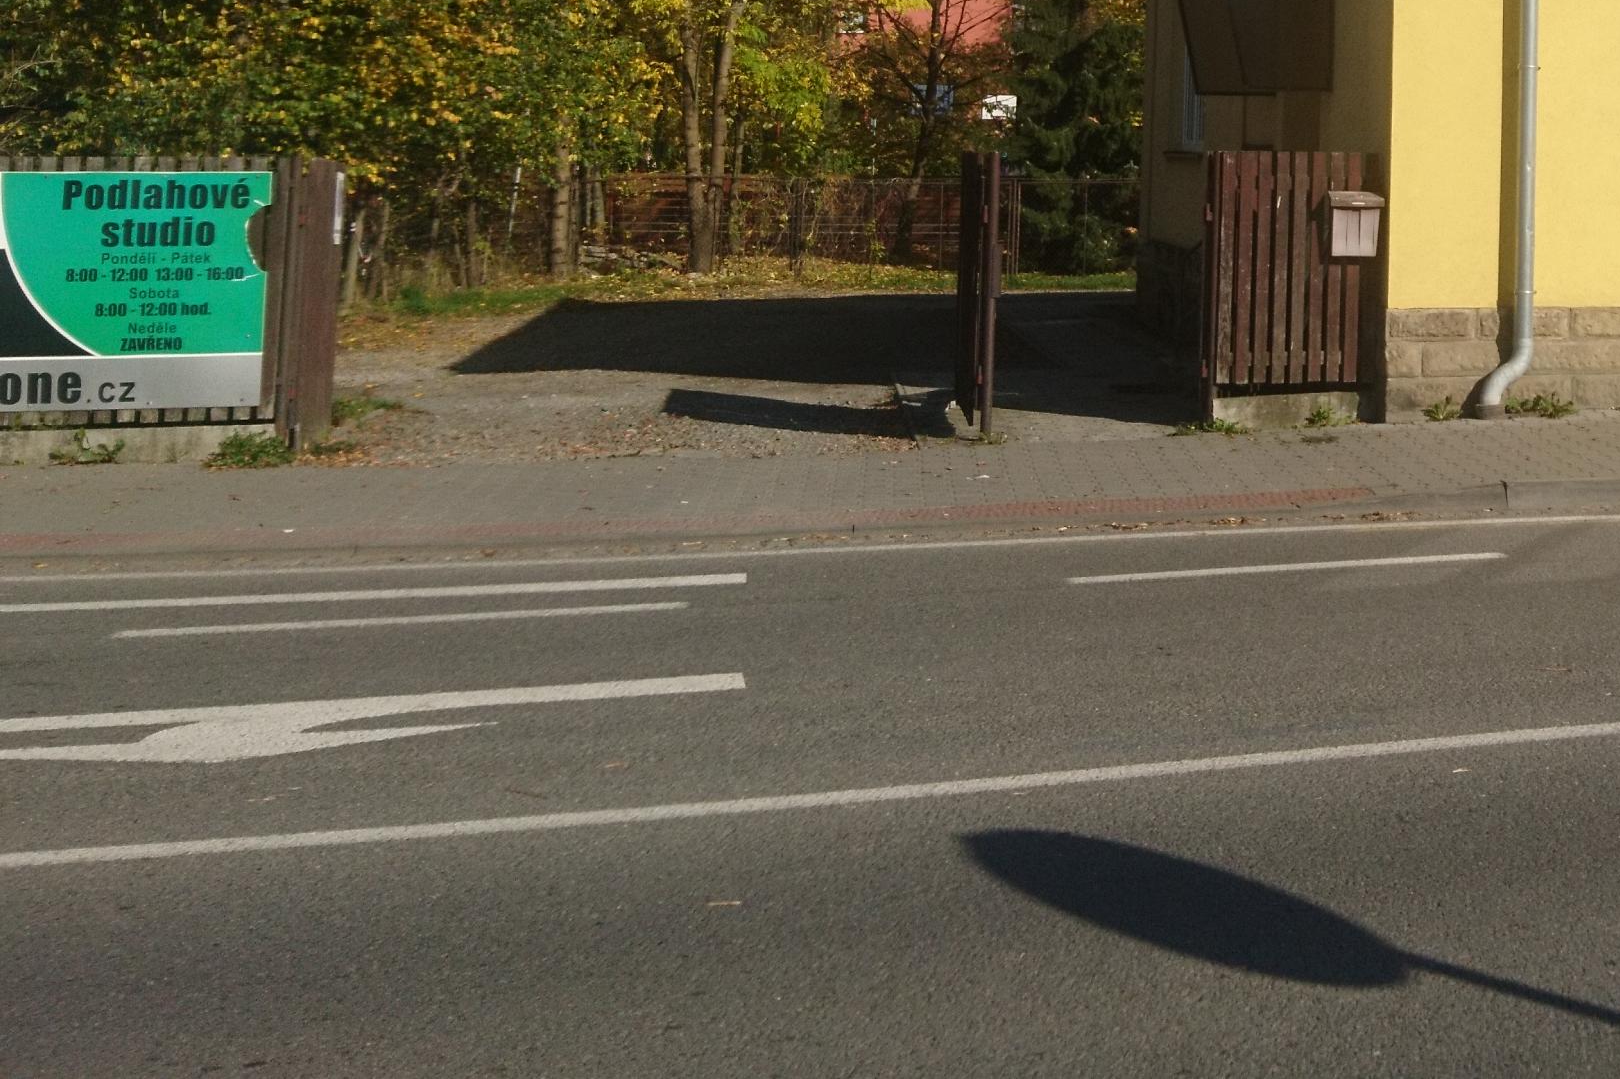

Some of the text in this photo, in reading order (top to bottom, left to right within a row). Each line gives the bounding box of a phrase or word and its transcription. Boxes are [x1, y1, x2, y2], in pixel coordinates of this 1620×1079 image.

[62, 177, 250, 210] Podlahové
[101, 216, 216, 248] studio
[171, 252, 211, 264] Pátek
[65, 268, 98, 282] 8:00
[110, 268, 148, 282] 12:00
[154, 267, 193, 281] 13:00
[205, 266, 244, 281] 16:00
[129, 287, 180, 299] Sobota
[94, 303, 127, 317] 8:00
[139, 302, 177, 316] 12:00
[180, 302, 212, 316] hod.
[127, 322, 177, 334] Neděle
[119, 334, 182, 352] ZAVŘENO
